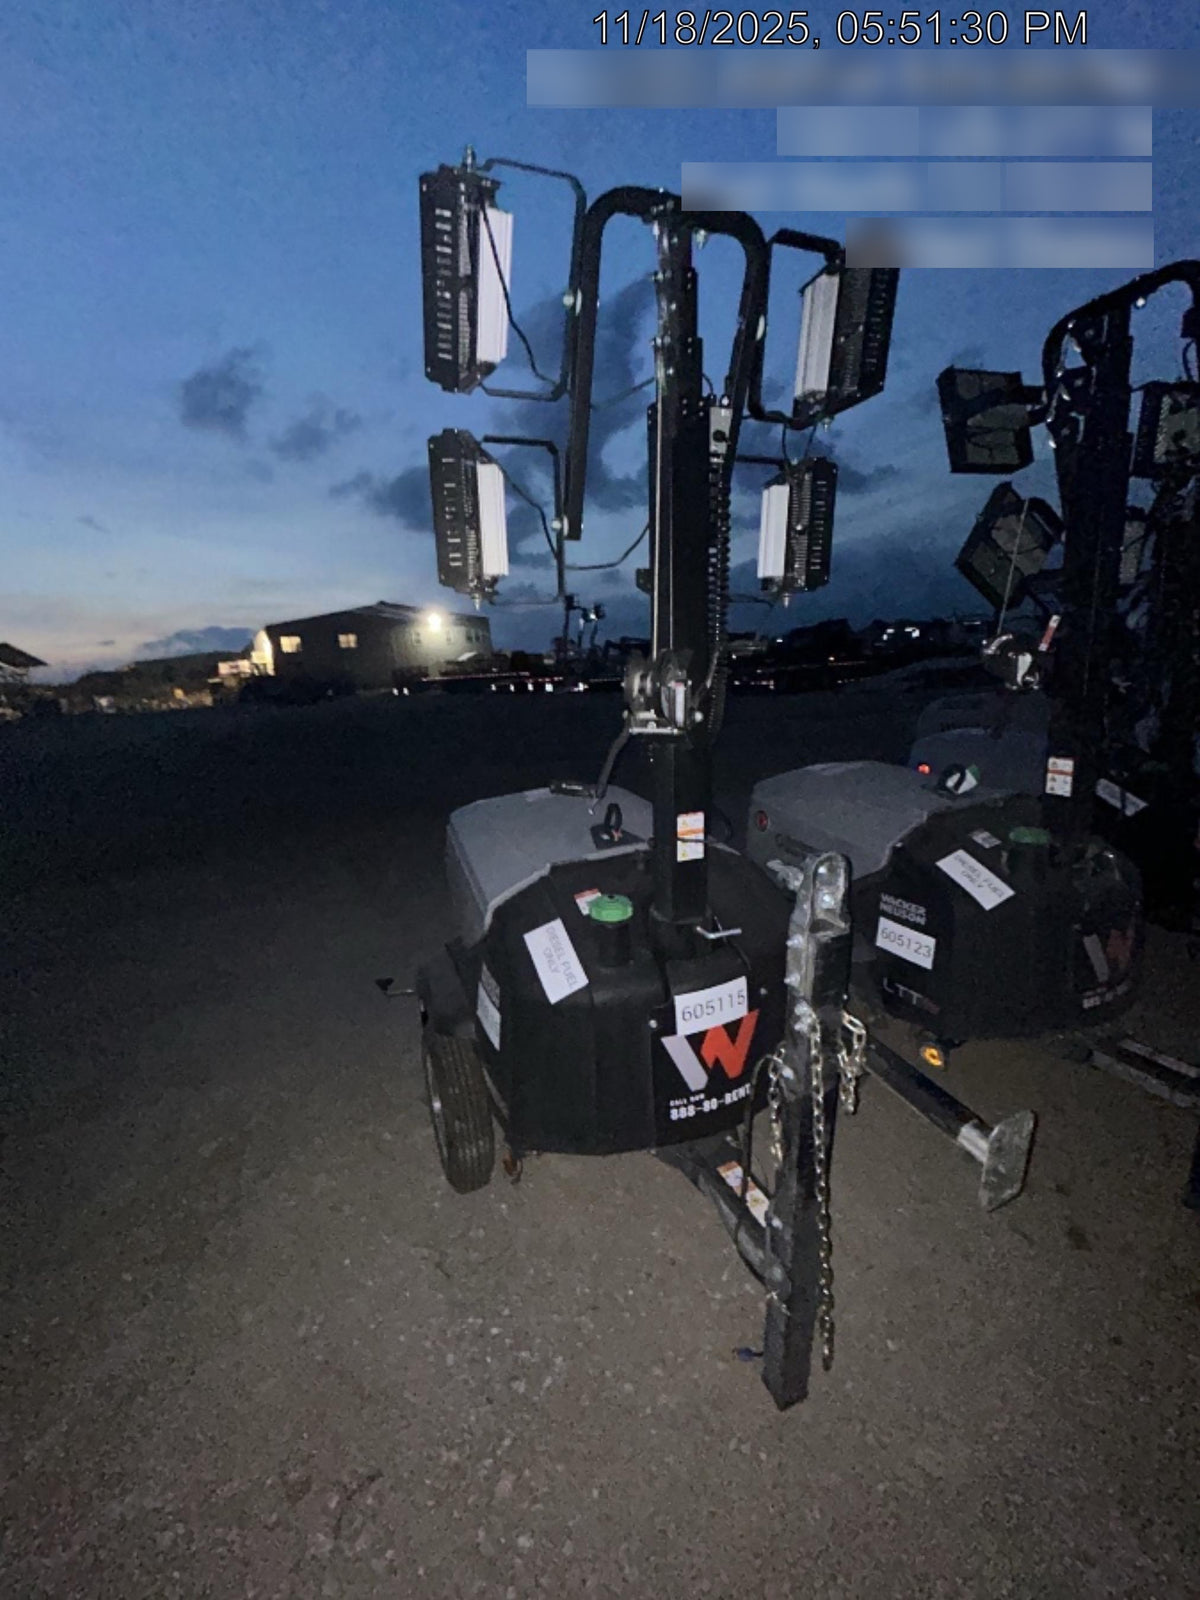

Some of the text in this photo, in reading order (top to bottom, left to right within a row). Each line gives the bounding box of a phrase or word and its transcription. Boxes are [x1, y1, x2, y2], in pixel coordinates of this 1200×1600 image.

[880, 927, 933, 959] 605123
[561, 960, 579, 989] FUEL
[681, 989, 746, 1022] 605115
